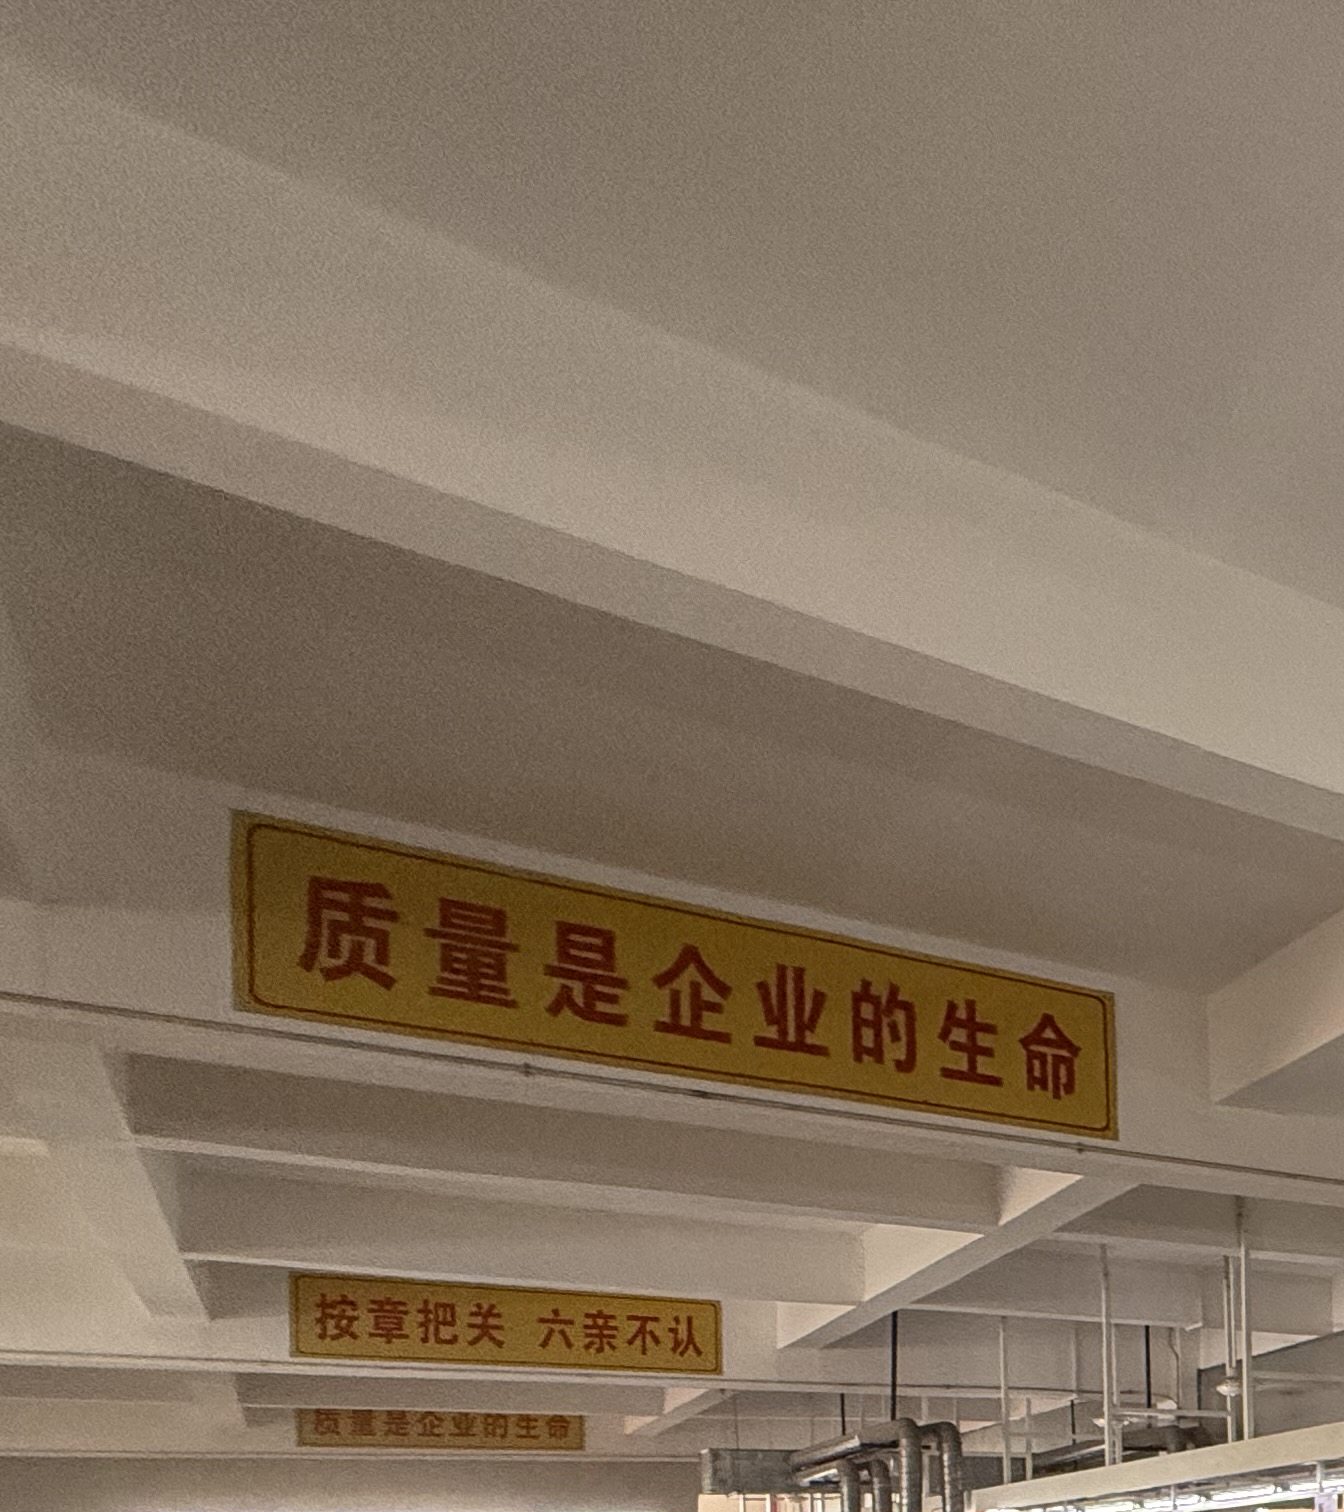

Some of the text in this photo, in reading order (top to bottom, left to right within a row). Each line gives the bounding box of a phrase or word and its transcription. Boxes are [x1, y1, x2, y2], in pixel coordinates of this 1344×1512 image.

[299, 874, 1083, 1101] 质量是企业的生命
[315, 1294, 703, 1358] 按章把关 六亲不认
[313, 1409, 571, 1441] 质量是企业的生命
